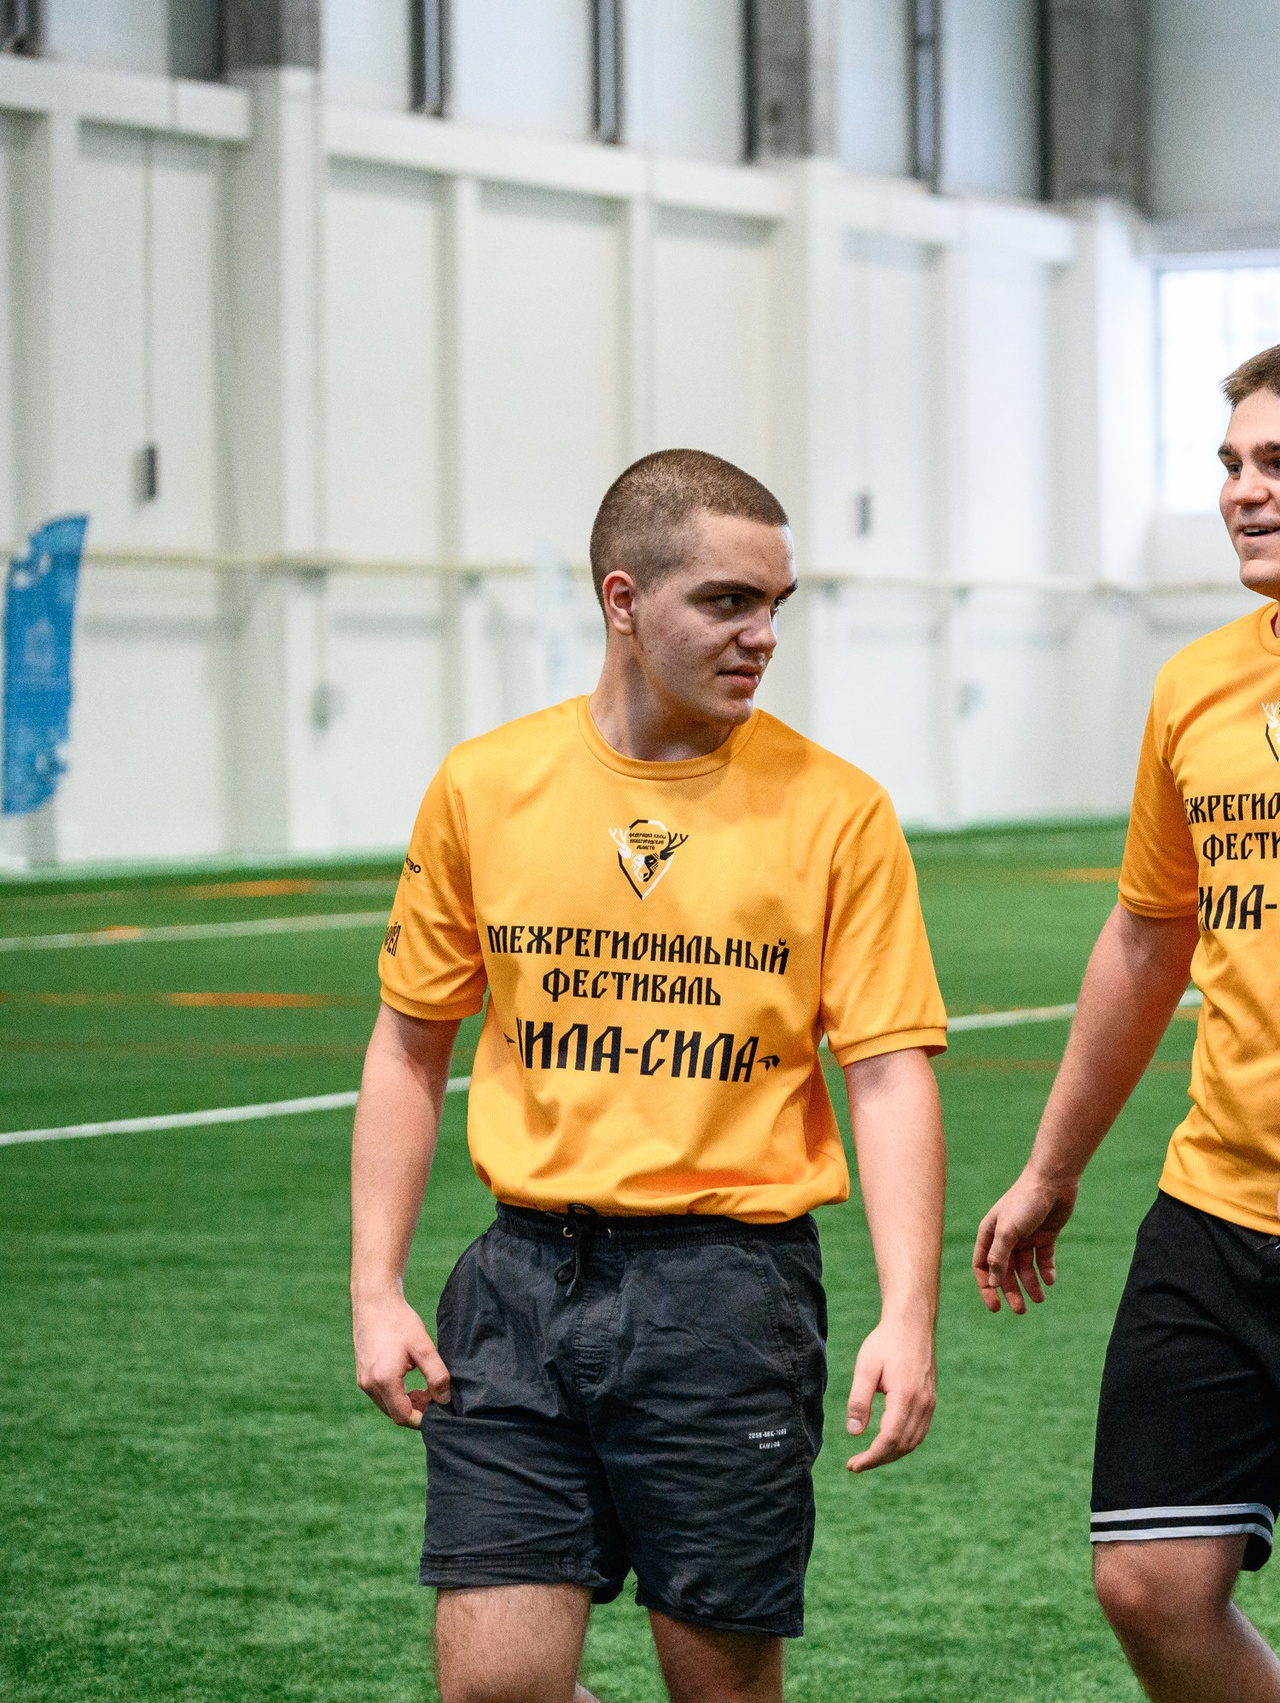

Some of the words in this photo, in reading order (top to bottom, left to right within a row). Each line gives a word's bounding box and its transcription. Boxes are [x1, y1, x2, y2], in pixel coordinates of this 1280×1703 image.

[487, 924, 790, 976] МЕЖРЕГИОНАЛЬНЫЙ
[542, 967, 721, 1006] ФЕСТИВАЛЬ
[516, 1017, 760, 1083] ИЛА-СИЛА
